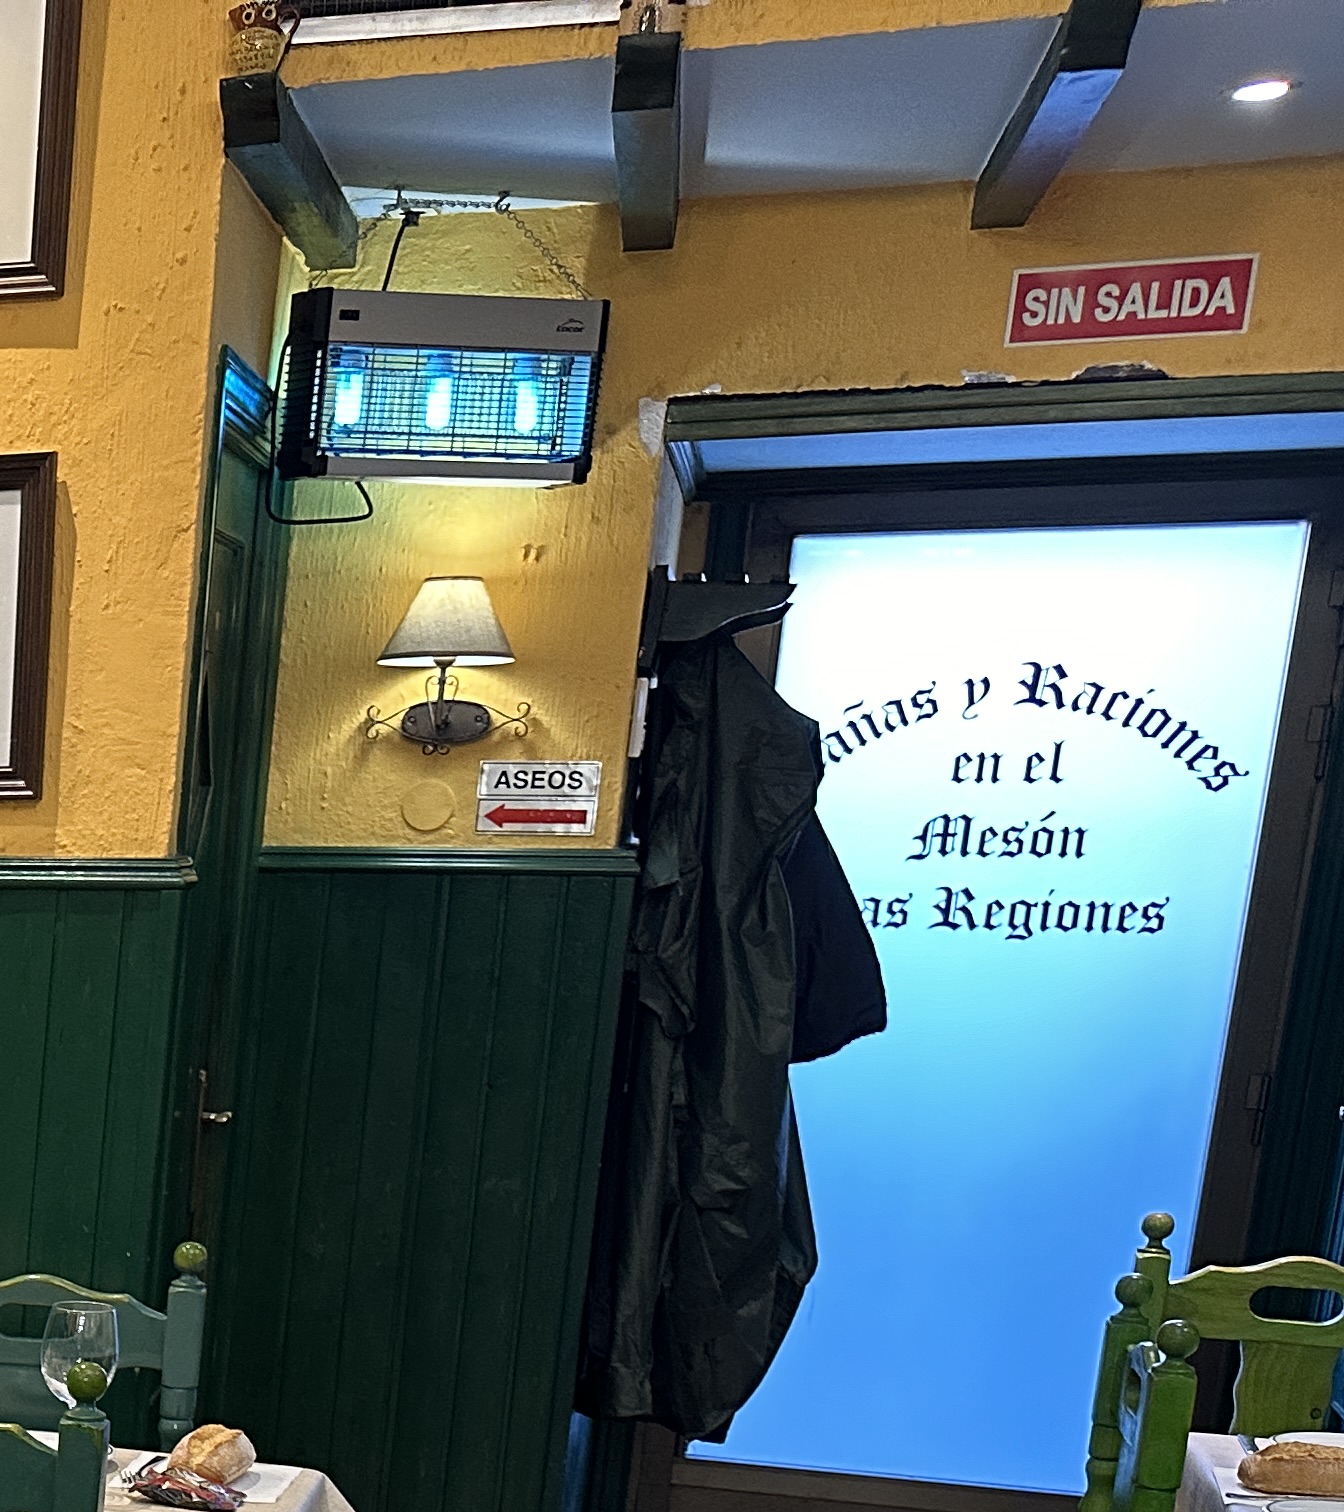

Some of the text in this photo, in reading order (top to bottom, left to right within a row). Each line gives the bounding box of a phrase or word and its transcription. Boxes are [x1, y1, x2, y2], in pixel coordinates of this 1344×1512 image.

[1021, 276, 1236, 328] SIN SALIDA
[821, 660, 1250, 794] añas y Raciones
[494, 769, 584, 790] ASEOS
[951, 740, 1065, 785] en el
[904, 810, 1089, 862] Mesón
[861, 886, 1170, 941] as Regiones
